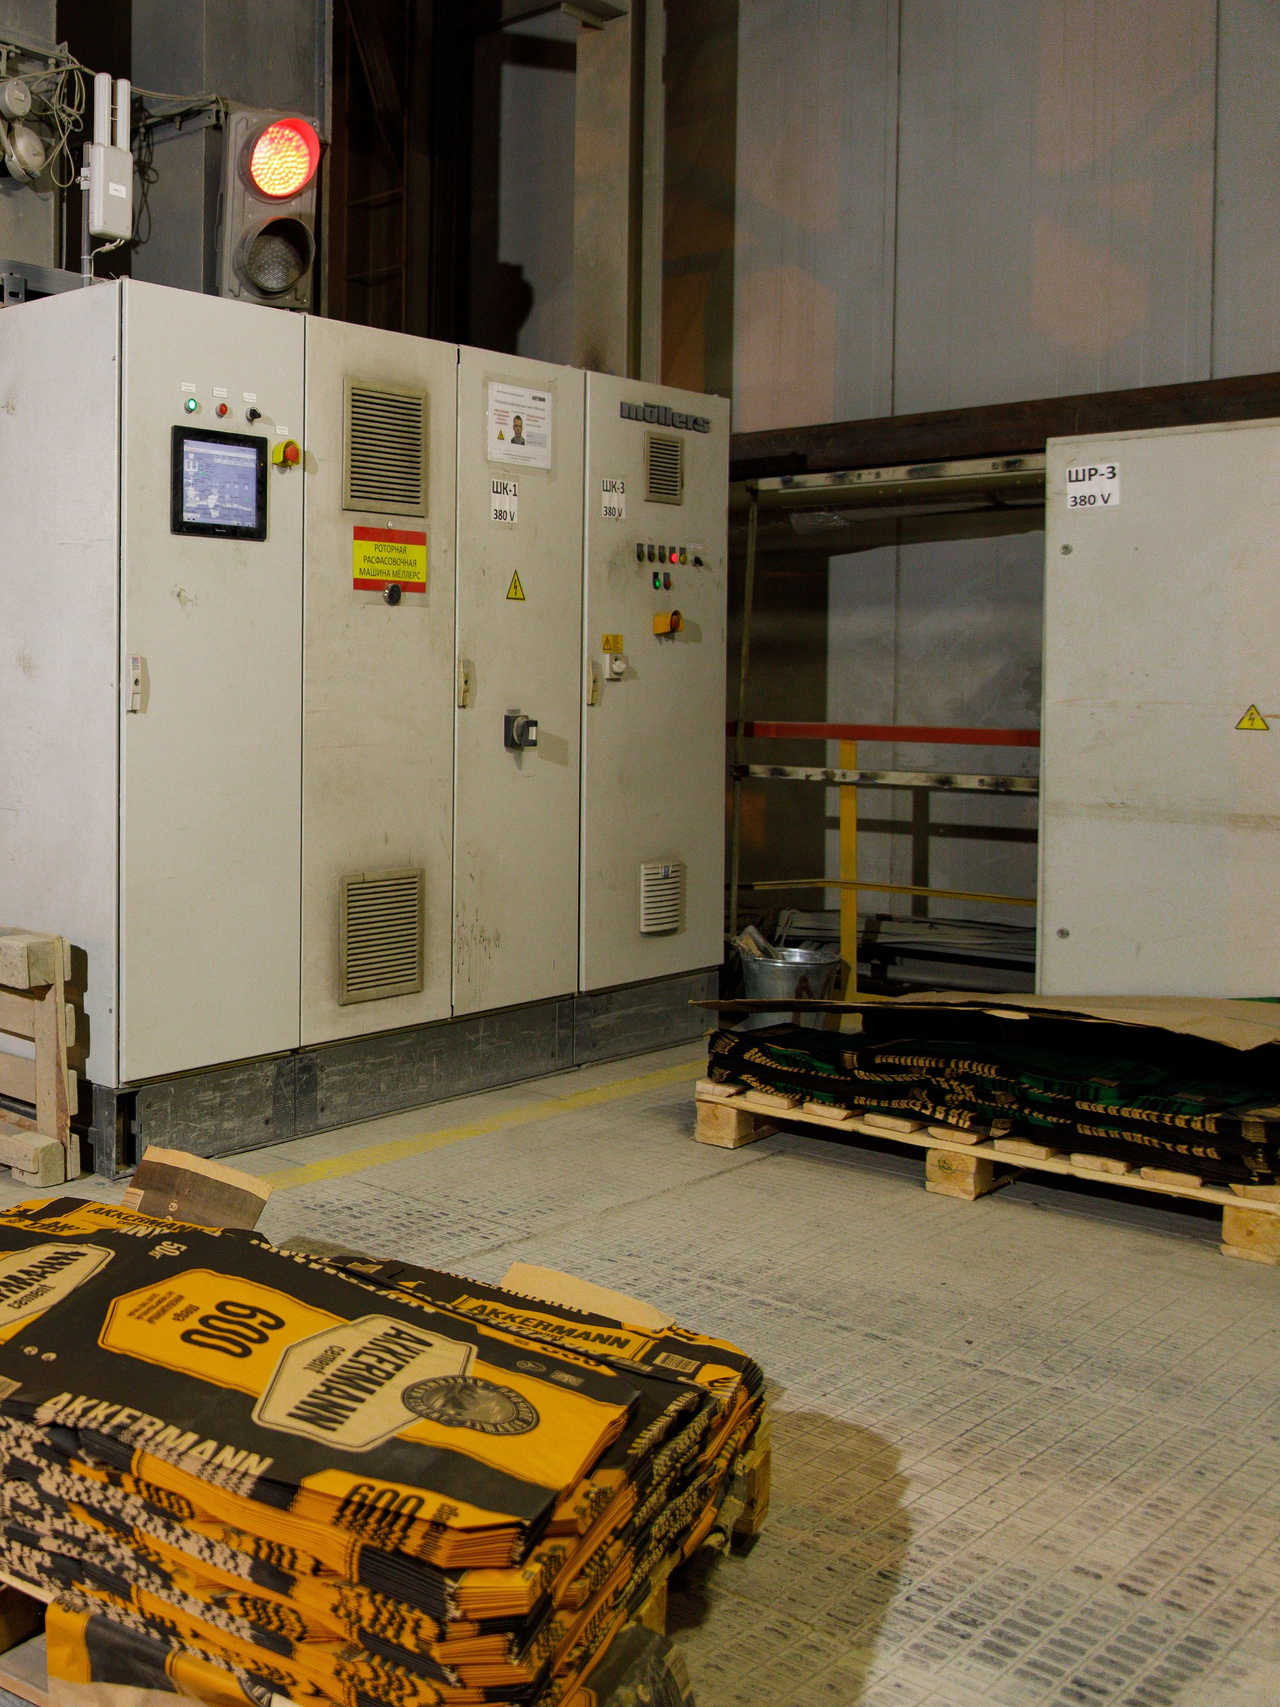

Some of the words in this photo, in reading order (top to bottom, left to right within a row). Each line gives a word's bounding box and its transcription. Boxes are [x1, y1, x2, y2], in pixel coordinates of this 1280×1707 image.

[1068, 465, 1117, 483] ШР-3
[492, 480, 518, 497] ШК-1
[602, 479, 625, 494] ШК-3
[1069, 494, 1097, 507] 380
[1100, 492, 1111, 505] V
[493, 508, 508, 521] 380
[509, 510, 516, 522] V
[603, 505, 616, 517] 380
[617, 507, 623, 518] V
[374, 543, 407, 554] РОТОРНАЯ
[362, 555, 417, 568] РАСФАСОВОЧНАЯ
[358, 567, 391, 578] МАШИНА
[6, 1282, 57, 1310] cement
[180, 1300, 286, 1359] 600
[471, 1303, 631, 1350] AKKERMANN
[302, 1344, 347, 1375] cement
[284, 1324, 434, 1433] AKKERMANN
